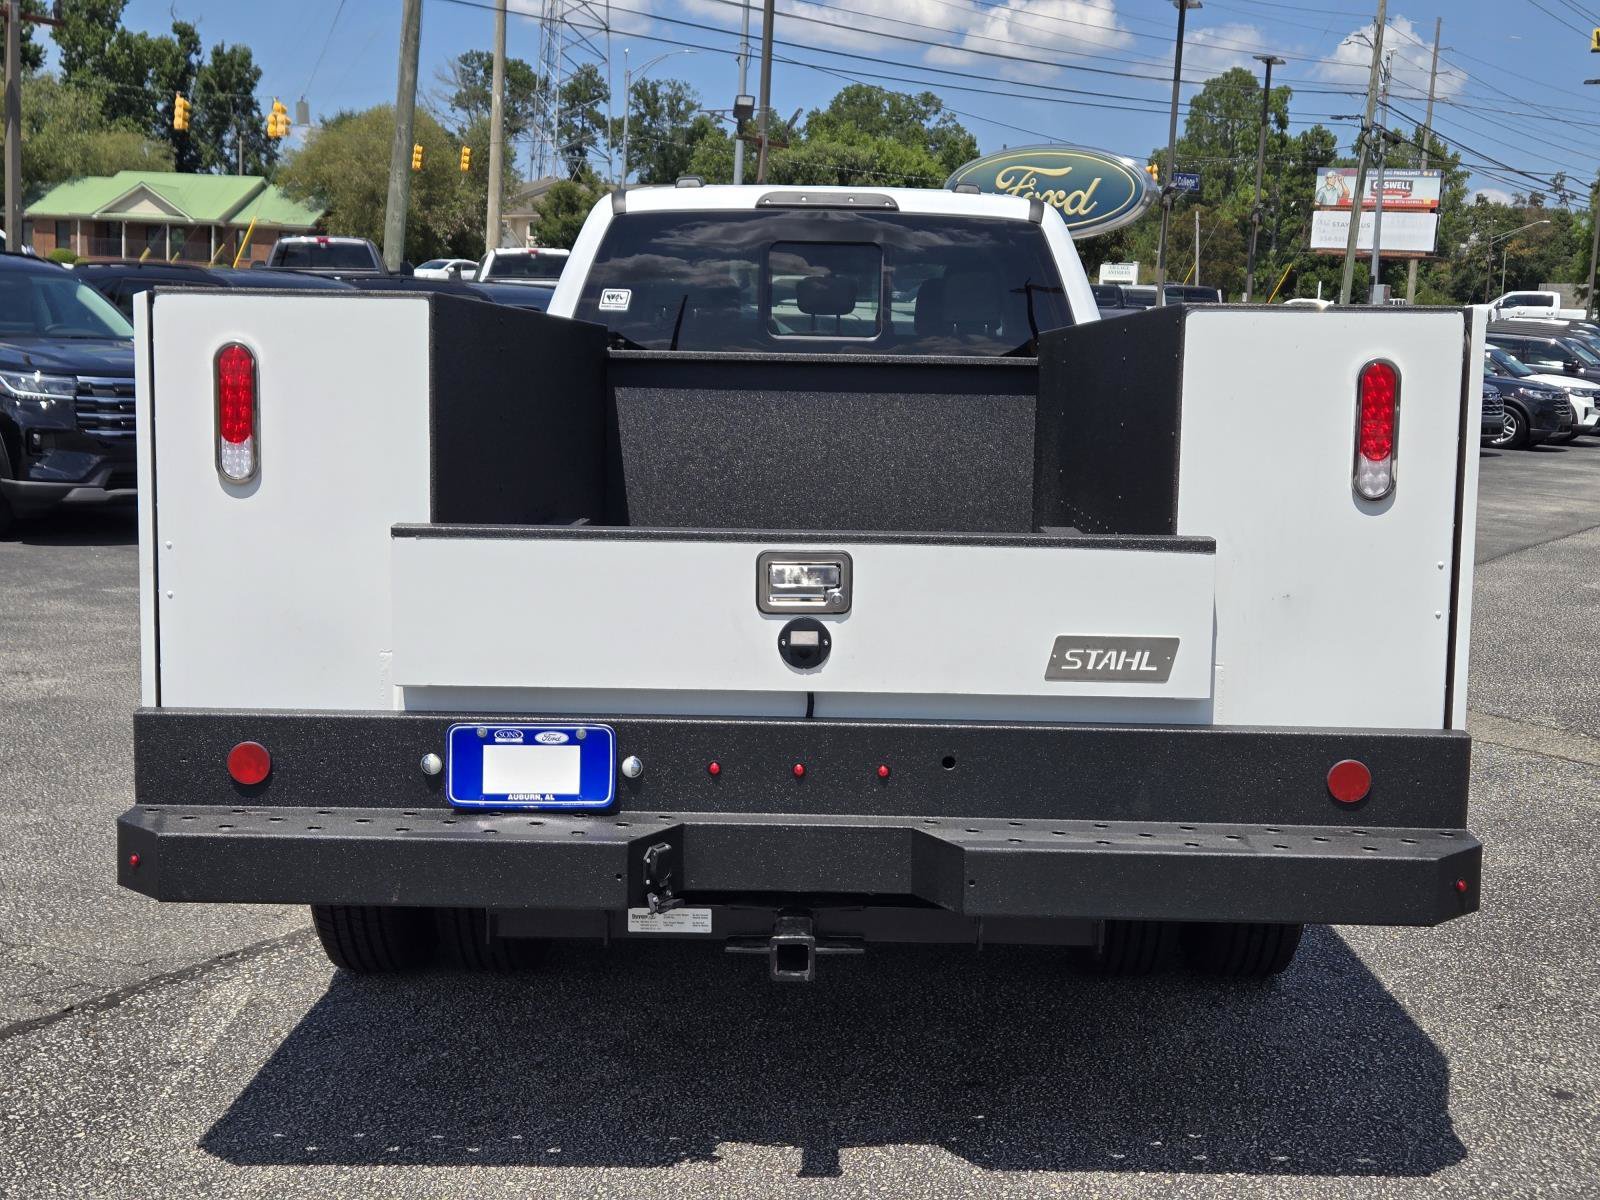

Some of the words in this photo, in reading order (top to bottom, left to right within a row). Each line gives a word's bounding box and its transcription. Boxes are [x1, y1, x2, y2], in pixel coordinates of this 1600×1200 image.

[1178, 175, 1196, 188] College
[1373, 181, 1411, 190] CSWELL
[995, 165, 1102, 216] Ford
[1061, 649, 1157, 671] STAHL
[498, 731, 520, 739] SONS
[541, 733, 562, 742] Ford
[507, 793, 543, 801] AUBURN,
